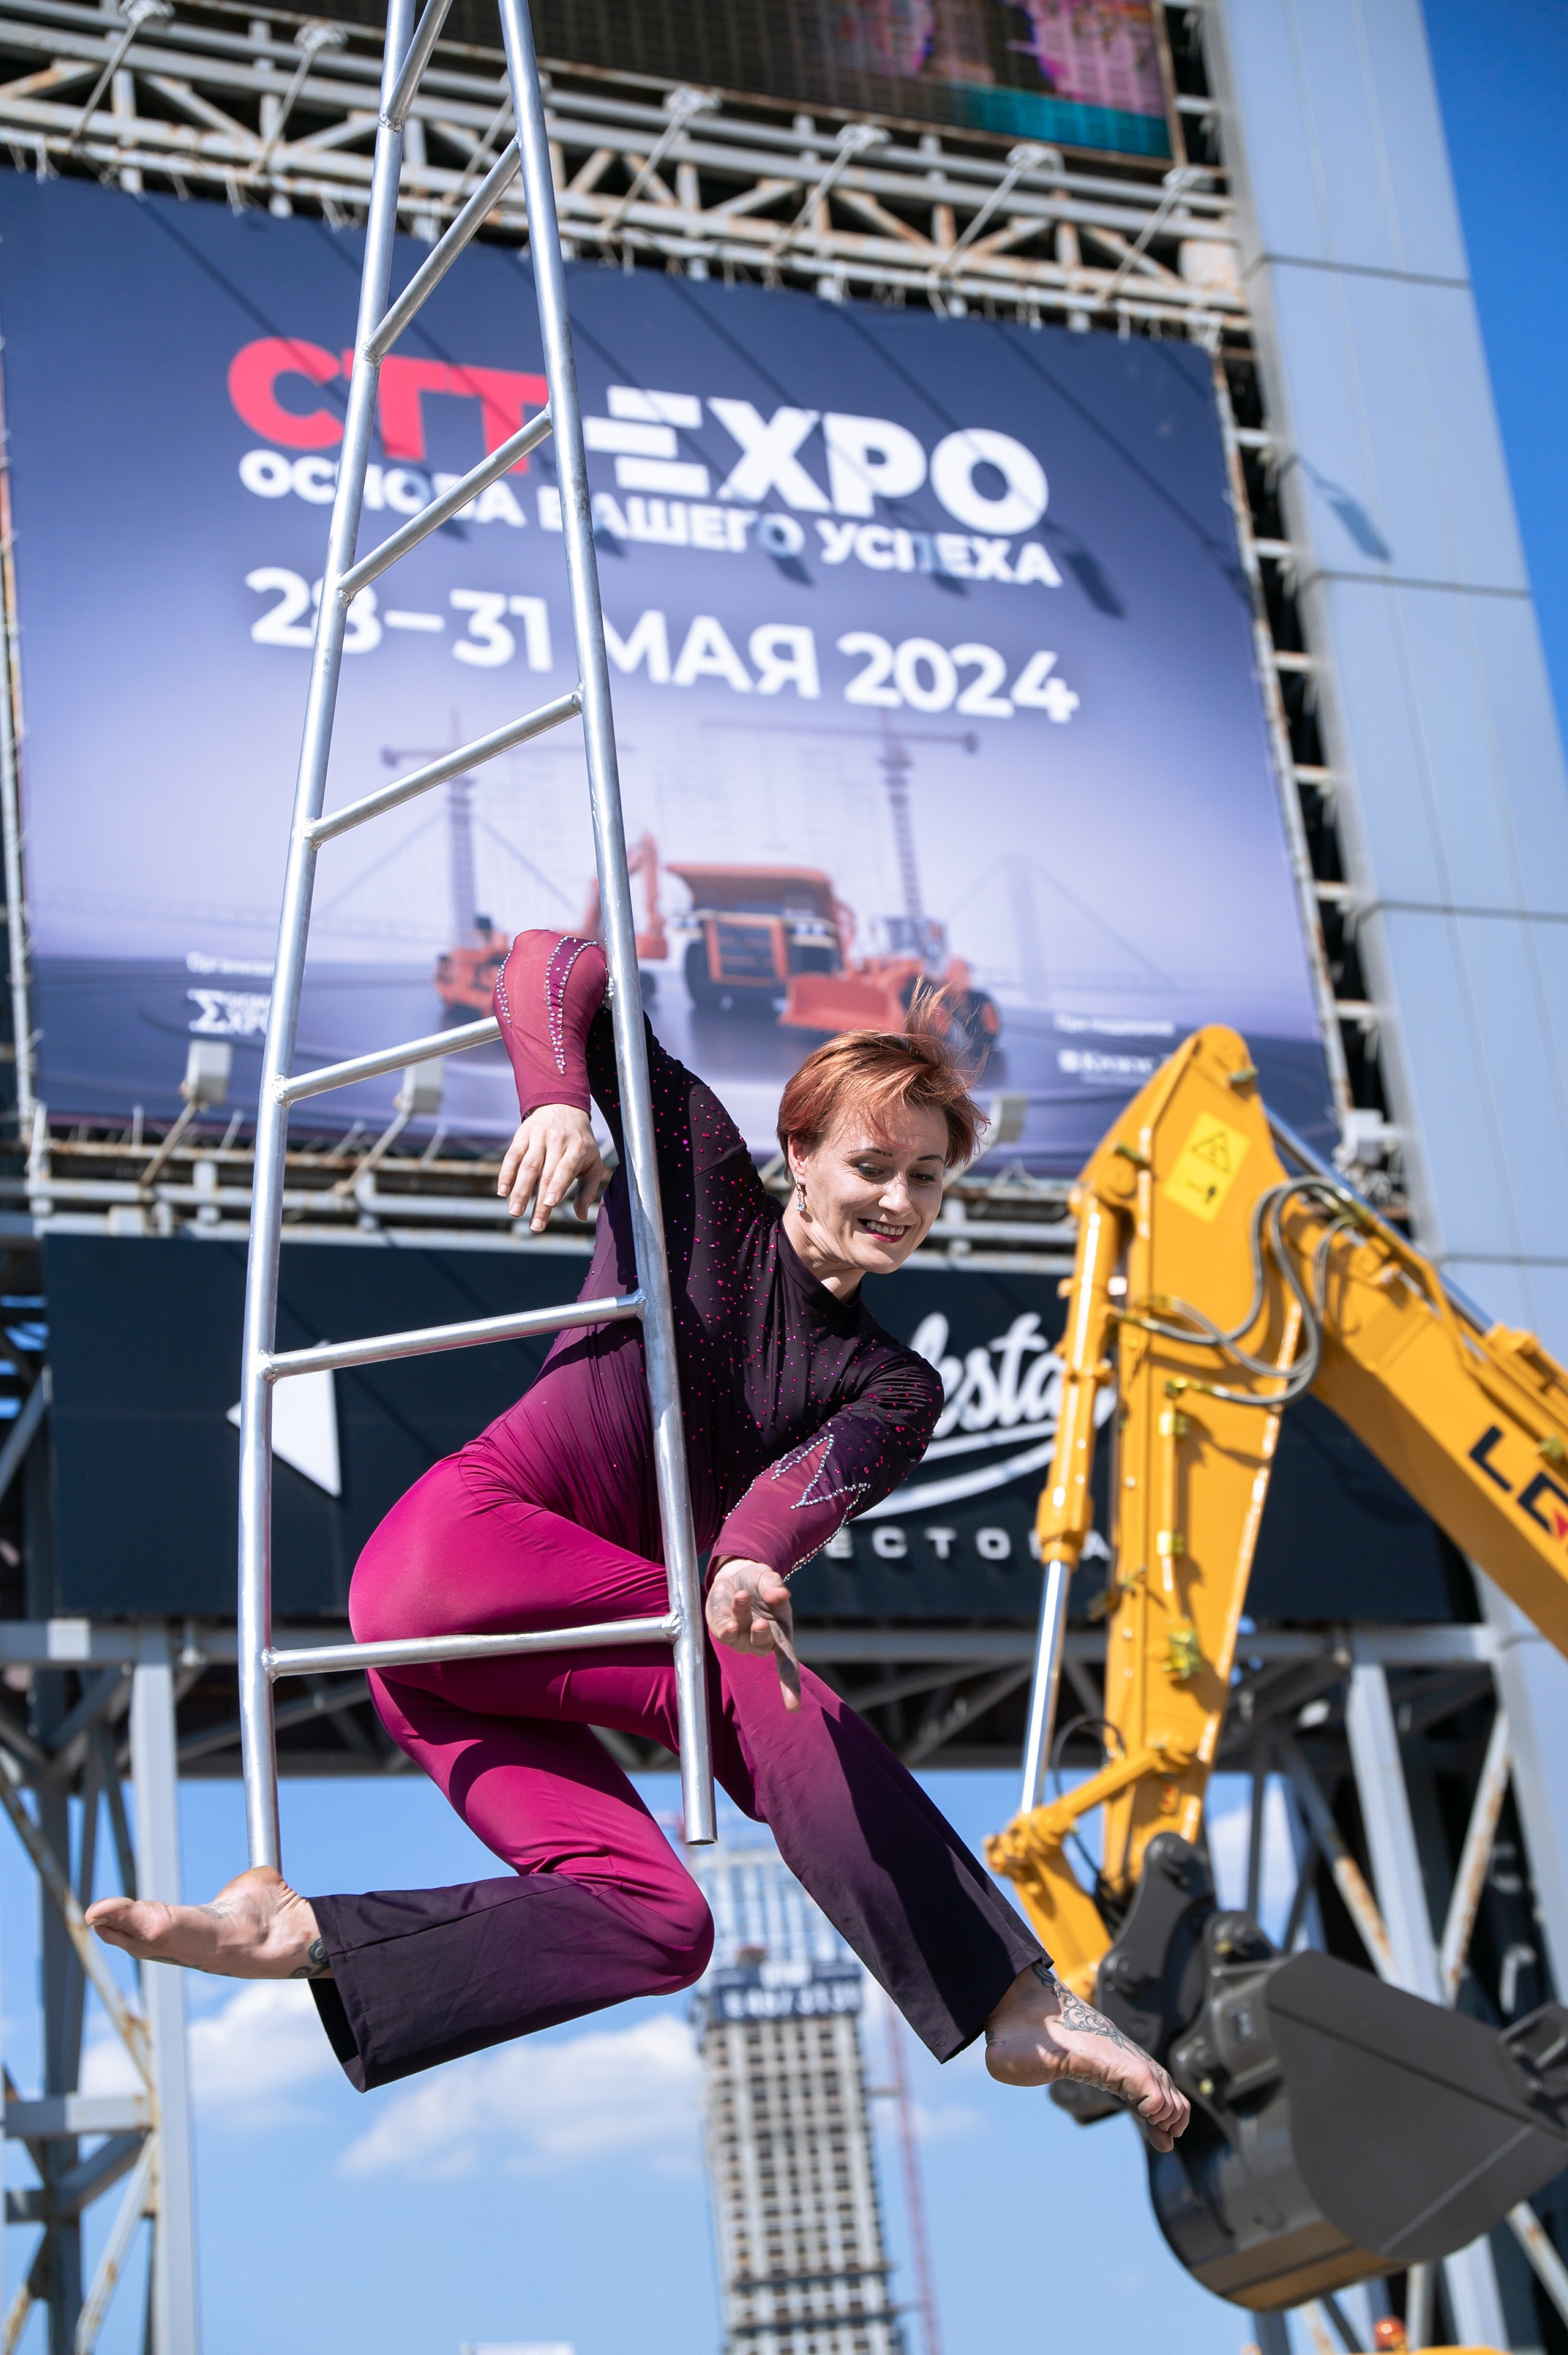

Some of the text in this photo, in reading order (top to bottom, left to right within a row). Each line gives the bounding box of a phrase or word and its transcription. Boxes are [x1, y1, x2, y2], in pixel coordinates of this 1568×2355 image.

[582, 384, 1049, 535] EXPO
[815, 518, 1063, 589] УСПЕХА
[603, 609, 822, 700] МАЯ
[837, 632, 1080, 724] 2024
